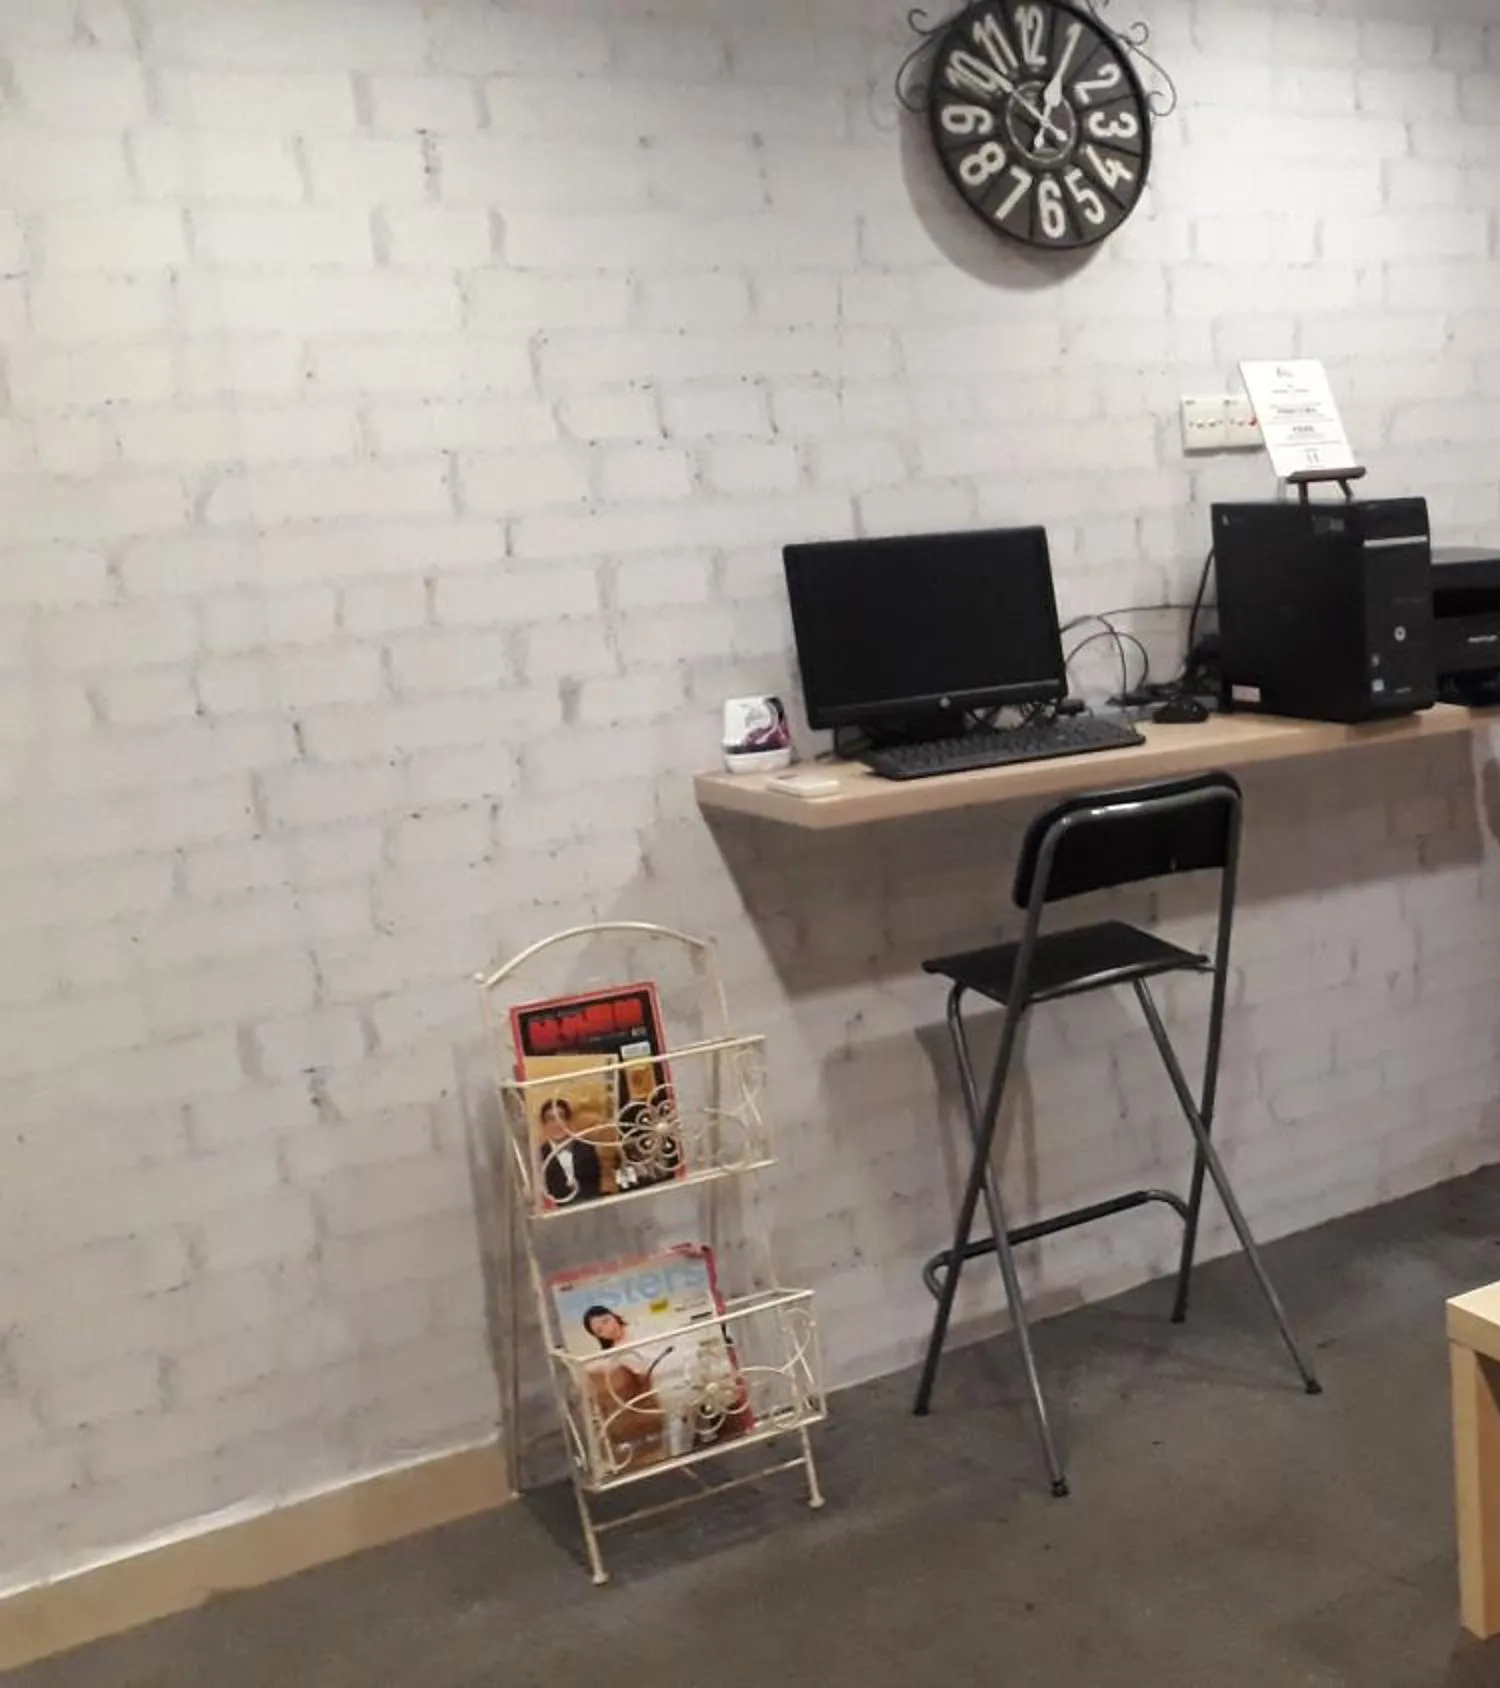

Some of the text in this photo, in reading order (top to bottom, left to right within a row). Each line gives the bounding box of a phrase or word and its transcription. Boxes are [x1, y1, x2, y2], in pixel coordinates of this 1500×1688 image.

[972, 14, 1019, 75] 11
[1014, 5, 1047, 65] 12
[945, 49, 1003, 98] 10
[1073, 63, 1121, 104] 2
[941, 104, 993, 134] 9
[1088, 111, 1138, 138] 3
[959, 141, 1006, 186] 8
[1086, 144, 1133, 189] 4
[994, 164, 1033, 220] 7
[1037, 179, 1066, 239] 6
[1064, 167, 1105, 224] 5
